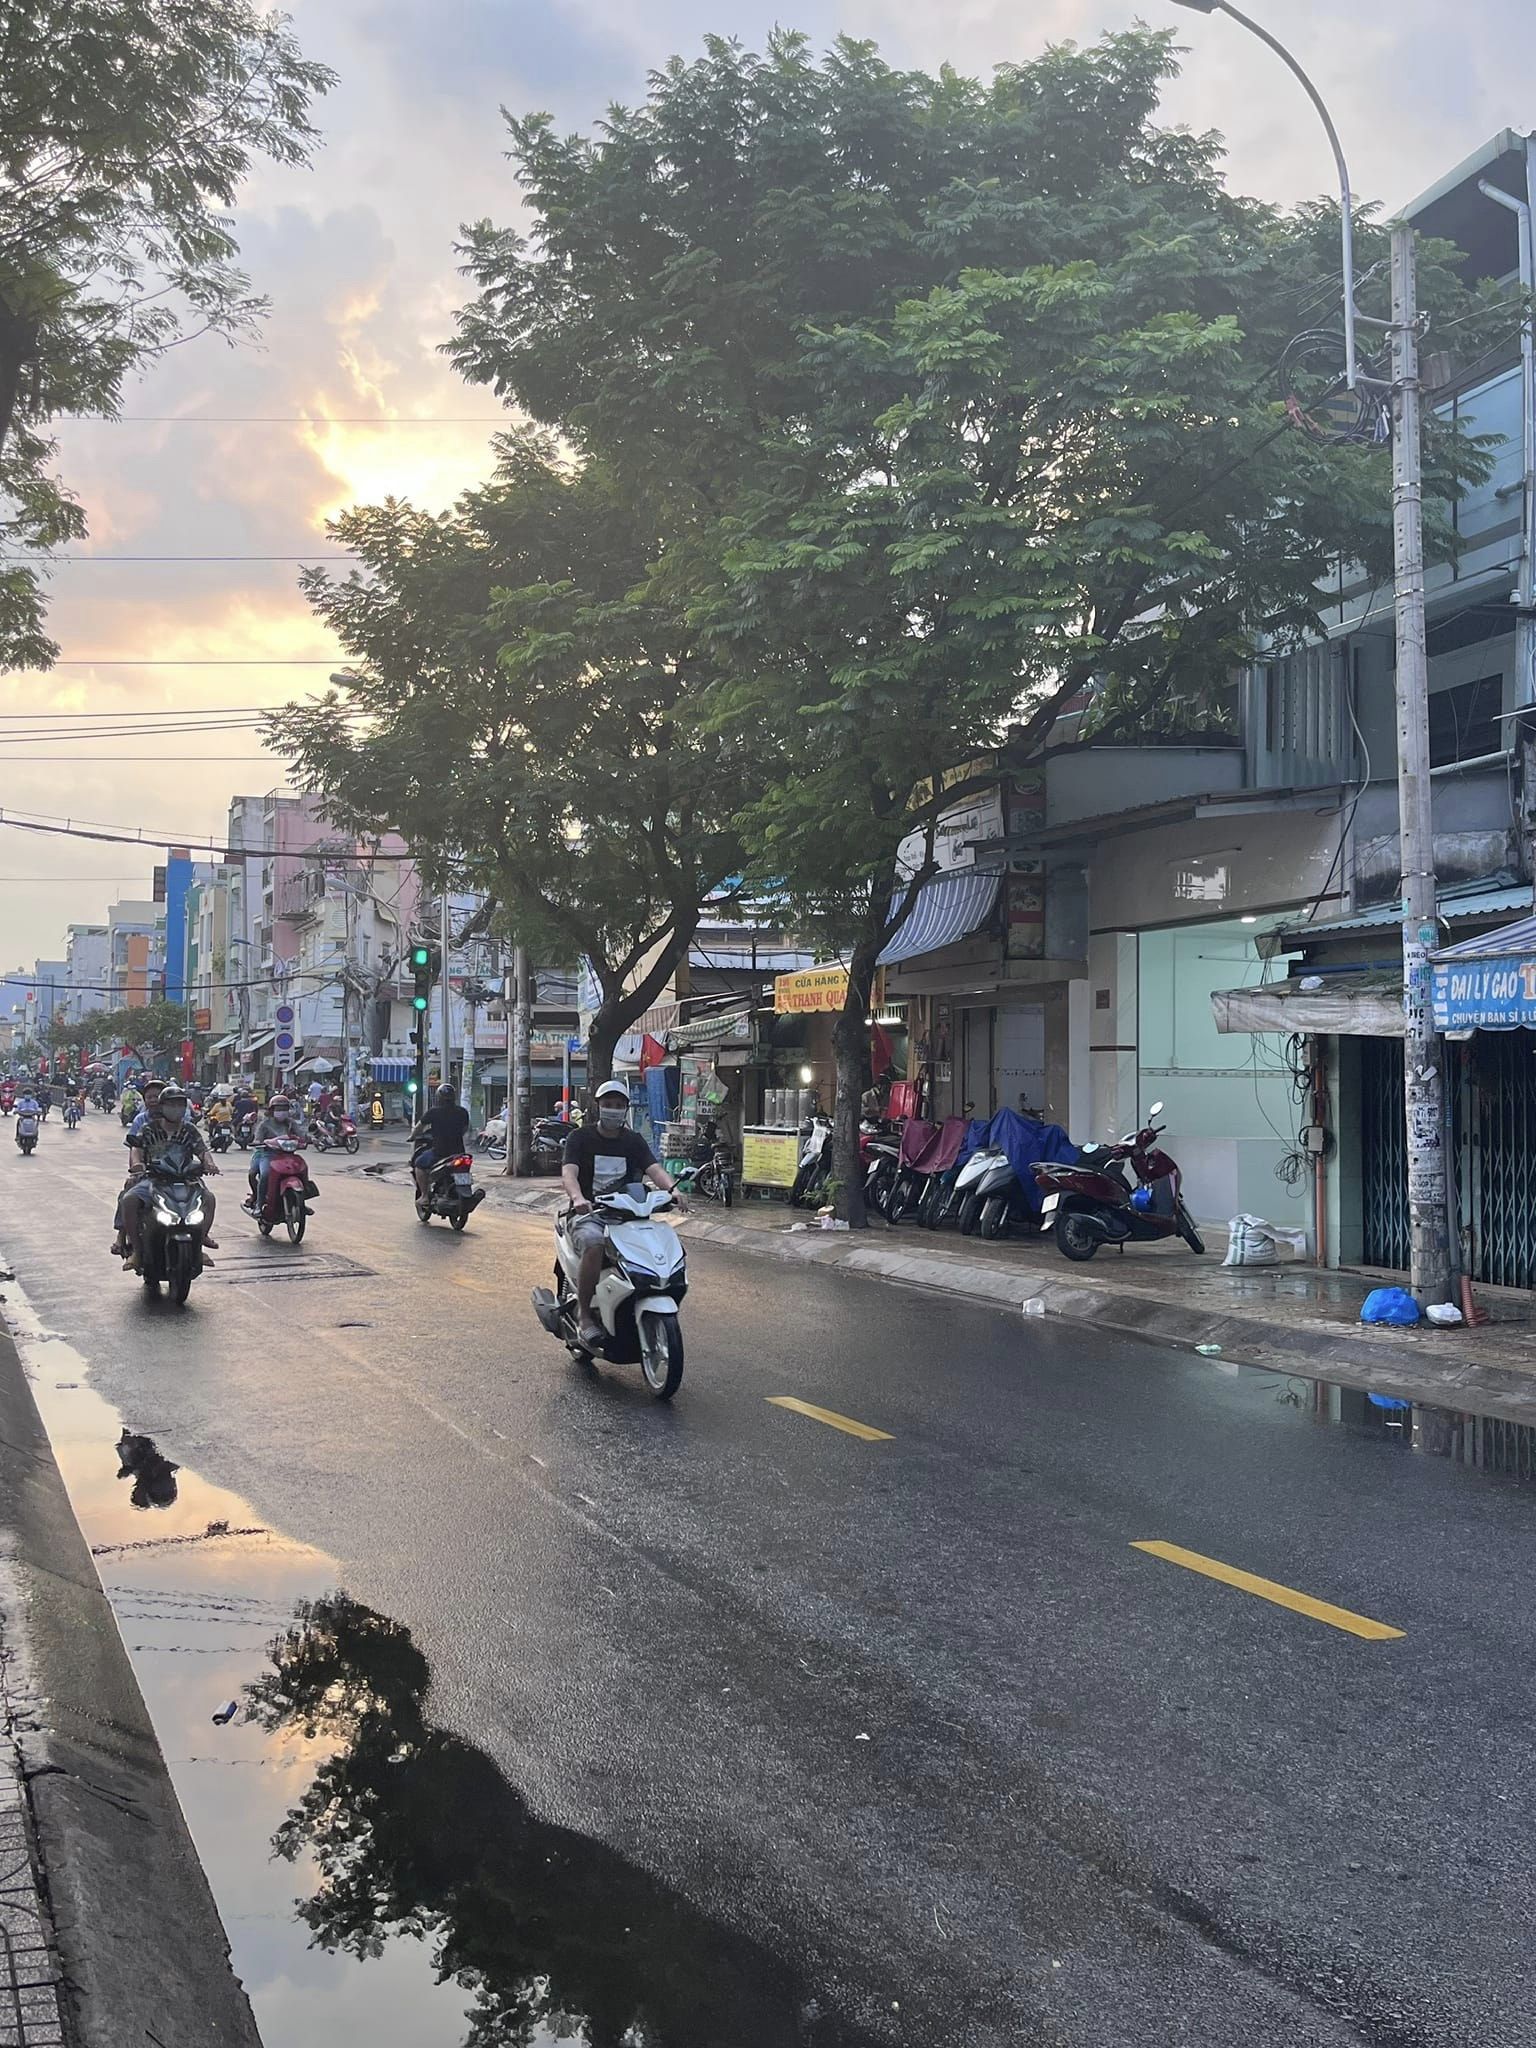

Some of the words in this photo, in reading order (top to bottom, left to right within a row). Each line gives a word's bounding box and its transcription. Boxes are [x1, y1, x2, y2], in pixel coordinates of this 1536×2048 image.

[792, 991, 823, 1009] THANH
[1450, 974, 1473, 1007] ĐẠI
[1474, 966, 1490, 1000] LÝ
[1491, 971, 1519, 1005] GẠO
